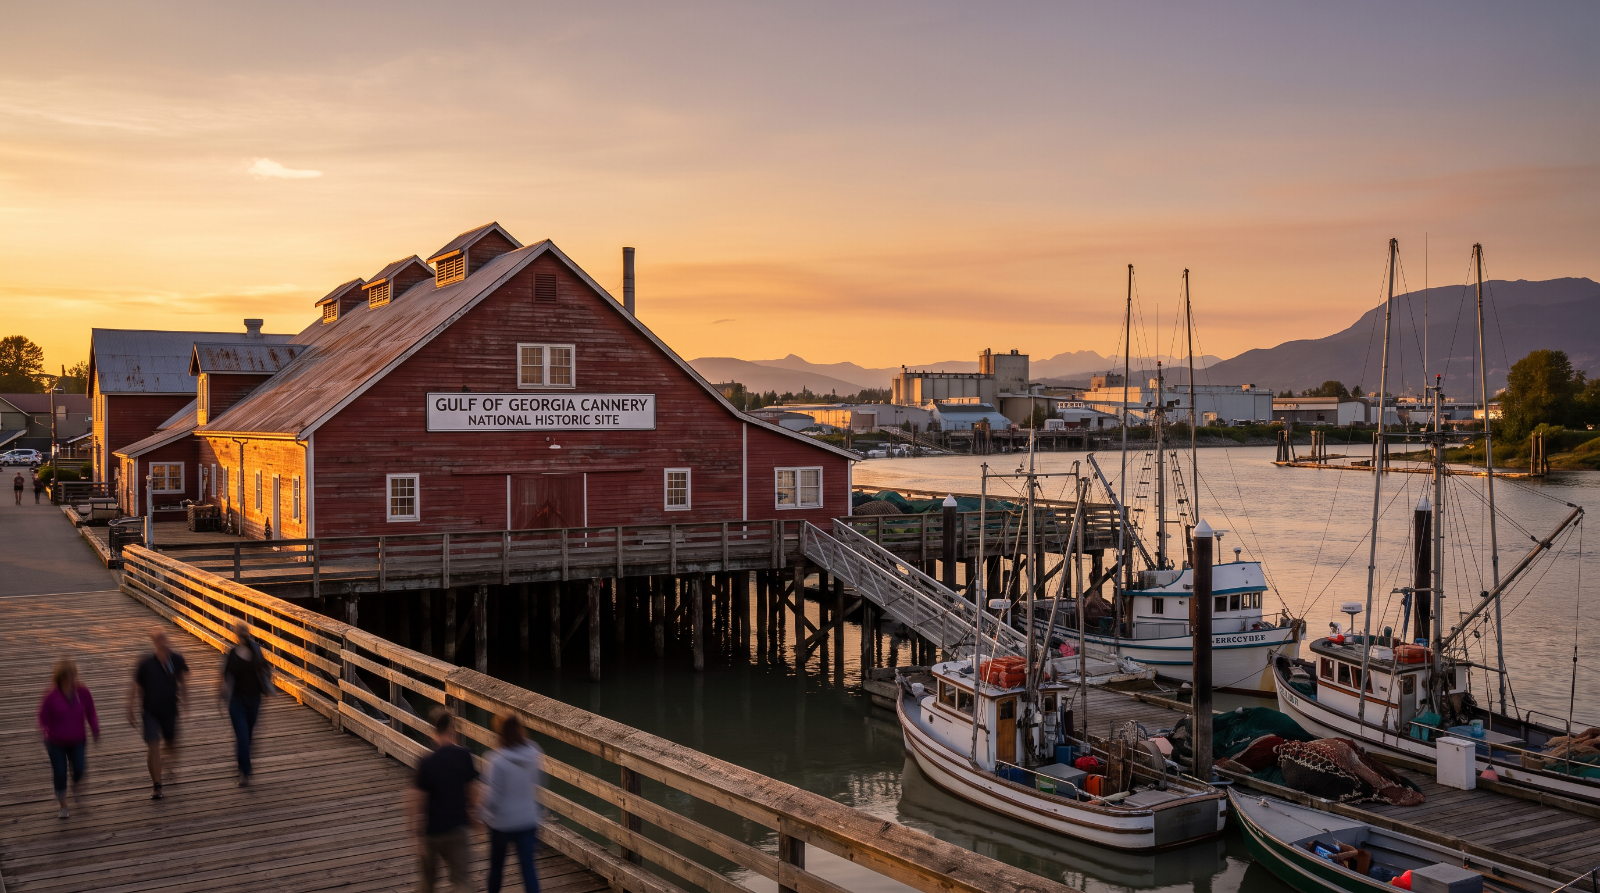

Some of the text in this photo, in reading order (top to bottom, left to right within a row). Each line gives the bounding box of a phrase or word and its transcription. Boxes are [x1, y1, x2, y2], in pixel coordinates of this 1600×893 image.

[435, 397, 648, 412] GULF OF GEORGIA CANNERY
[468, 414, 620, 426] NATIONAL HISTORIC SITE
